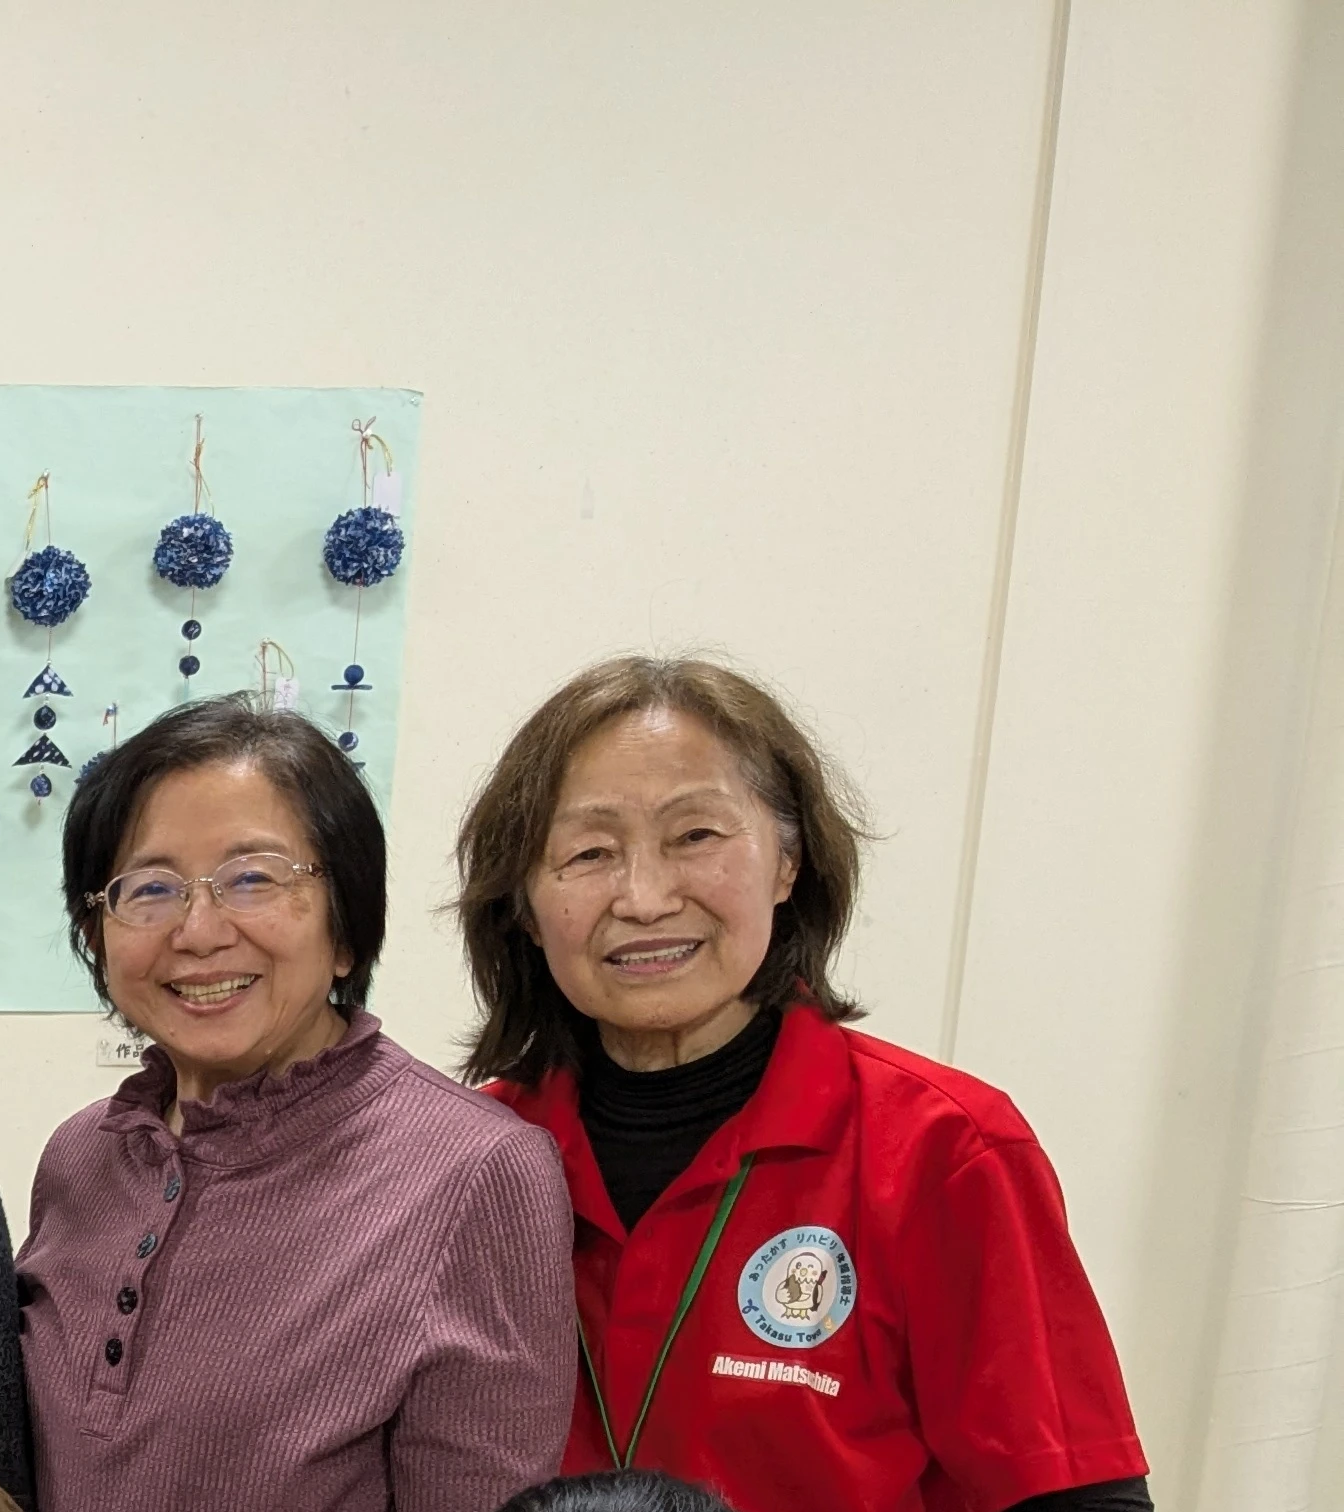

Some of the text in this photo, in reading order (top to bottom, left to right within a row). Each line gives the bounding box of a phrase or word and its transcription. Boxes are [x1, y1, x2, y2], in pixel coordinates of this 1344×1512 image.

[796, 1233, 838, 1251] リハビリ
[755, 1315, 792, 1343] Takasu
[712, 1355, 767, 1380] Akemi
